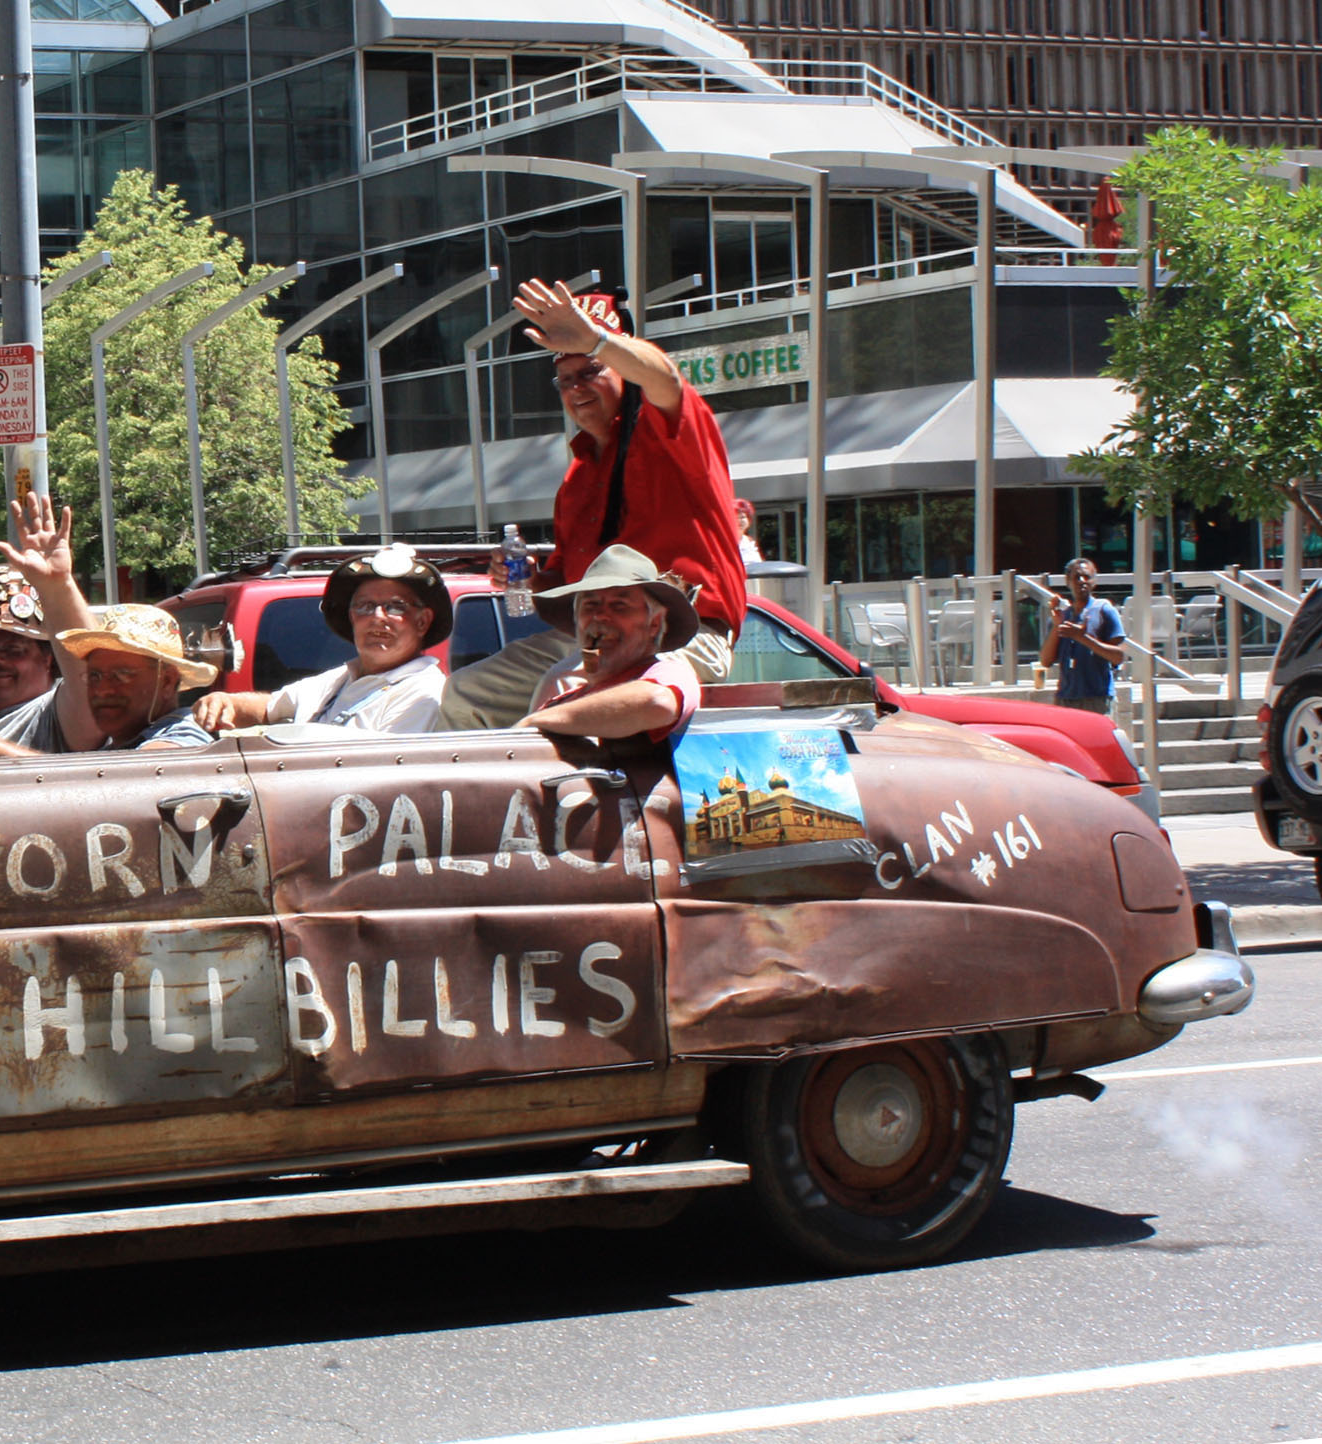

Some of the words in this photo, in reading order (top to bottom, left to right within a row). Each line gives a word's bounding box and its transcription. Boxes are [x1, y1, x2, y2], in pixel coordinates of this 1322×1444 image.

[12, 369, 29, 379] THIS
[12, 381, 29, 392] SIDE
[722, 344, 801, 381] COFFEE
[329, 788, 671, 880] PALACE
[875, 799, 974, 891] CLAN
[970, 814, 1042, 888] #161
